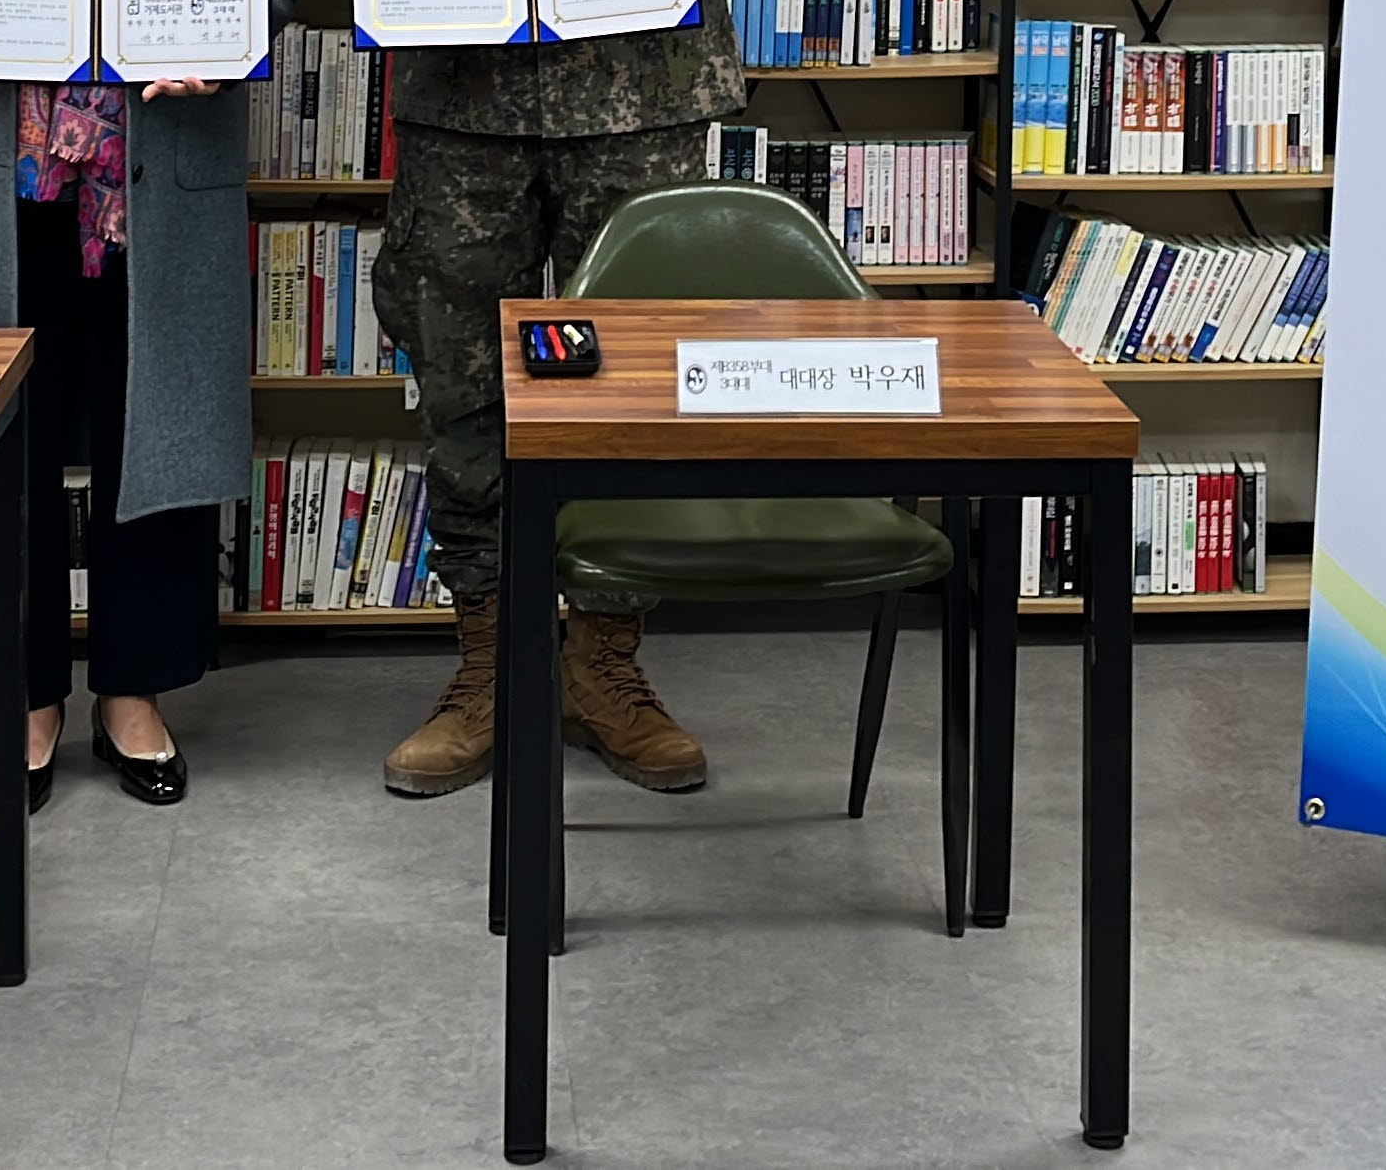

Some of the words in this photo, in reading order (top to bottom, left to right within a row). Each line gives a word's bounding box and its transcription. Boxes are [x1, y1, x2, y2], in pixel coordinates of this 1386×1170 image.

[297, 264, 305, 281] FBI
[272, 278, 281, 321] PATTERN
[284, 278, 293, 321] PATTERN
[710, 360, 773, 374] 제8358부대
[780, 367, 837, 391] 대대장
[849, 365, 925, 391] 박우재
[371, 499, 381, 516] FBI
